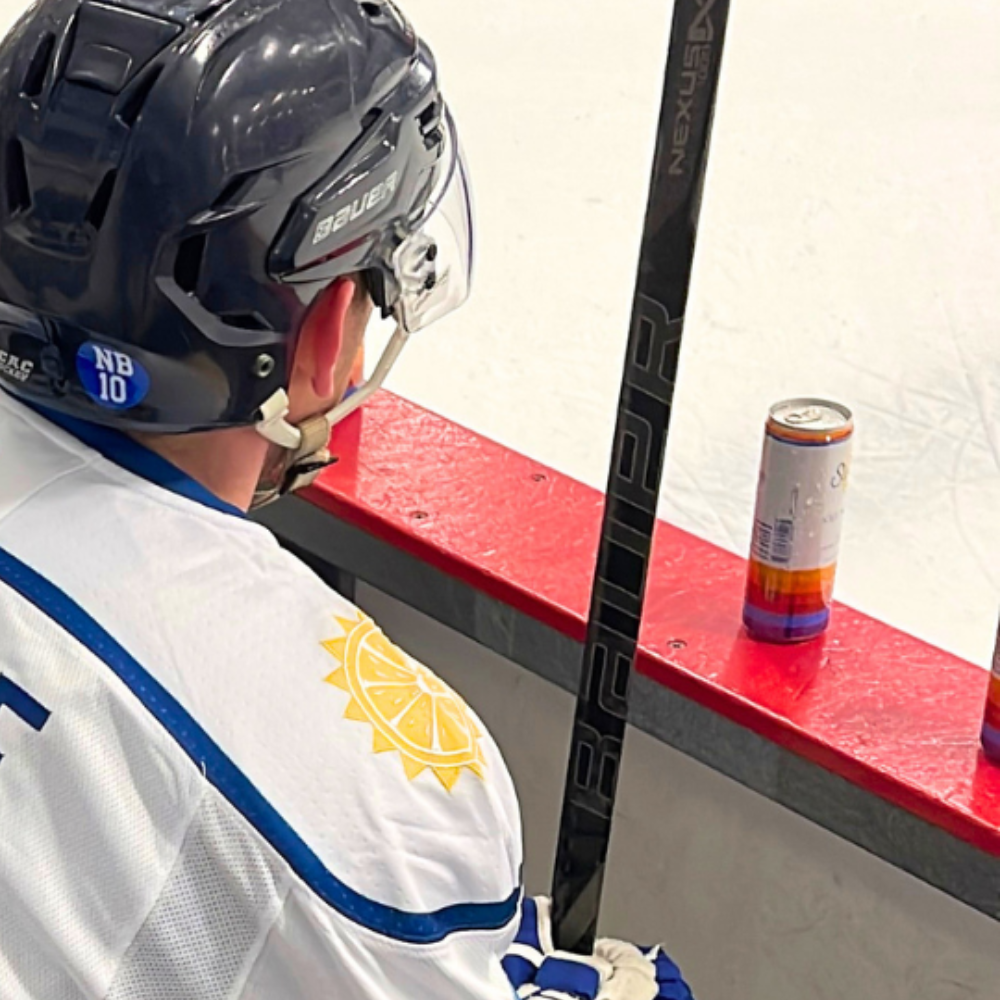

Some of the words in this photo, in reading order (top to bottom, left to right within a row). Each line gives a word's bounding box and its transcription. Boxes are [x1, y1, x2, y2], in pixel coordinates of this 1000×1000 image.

[668, 44, 700, 175] NEXUS
[312, 170, 397, 245] BAUER
[92, 344, 134, 378] NB
[100, 373, 127, 403] 10
